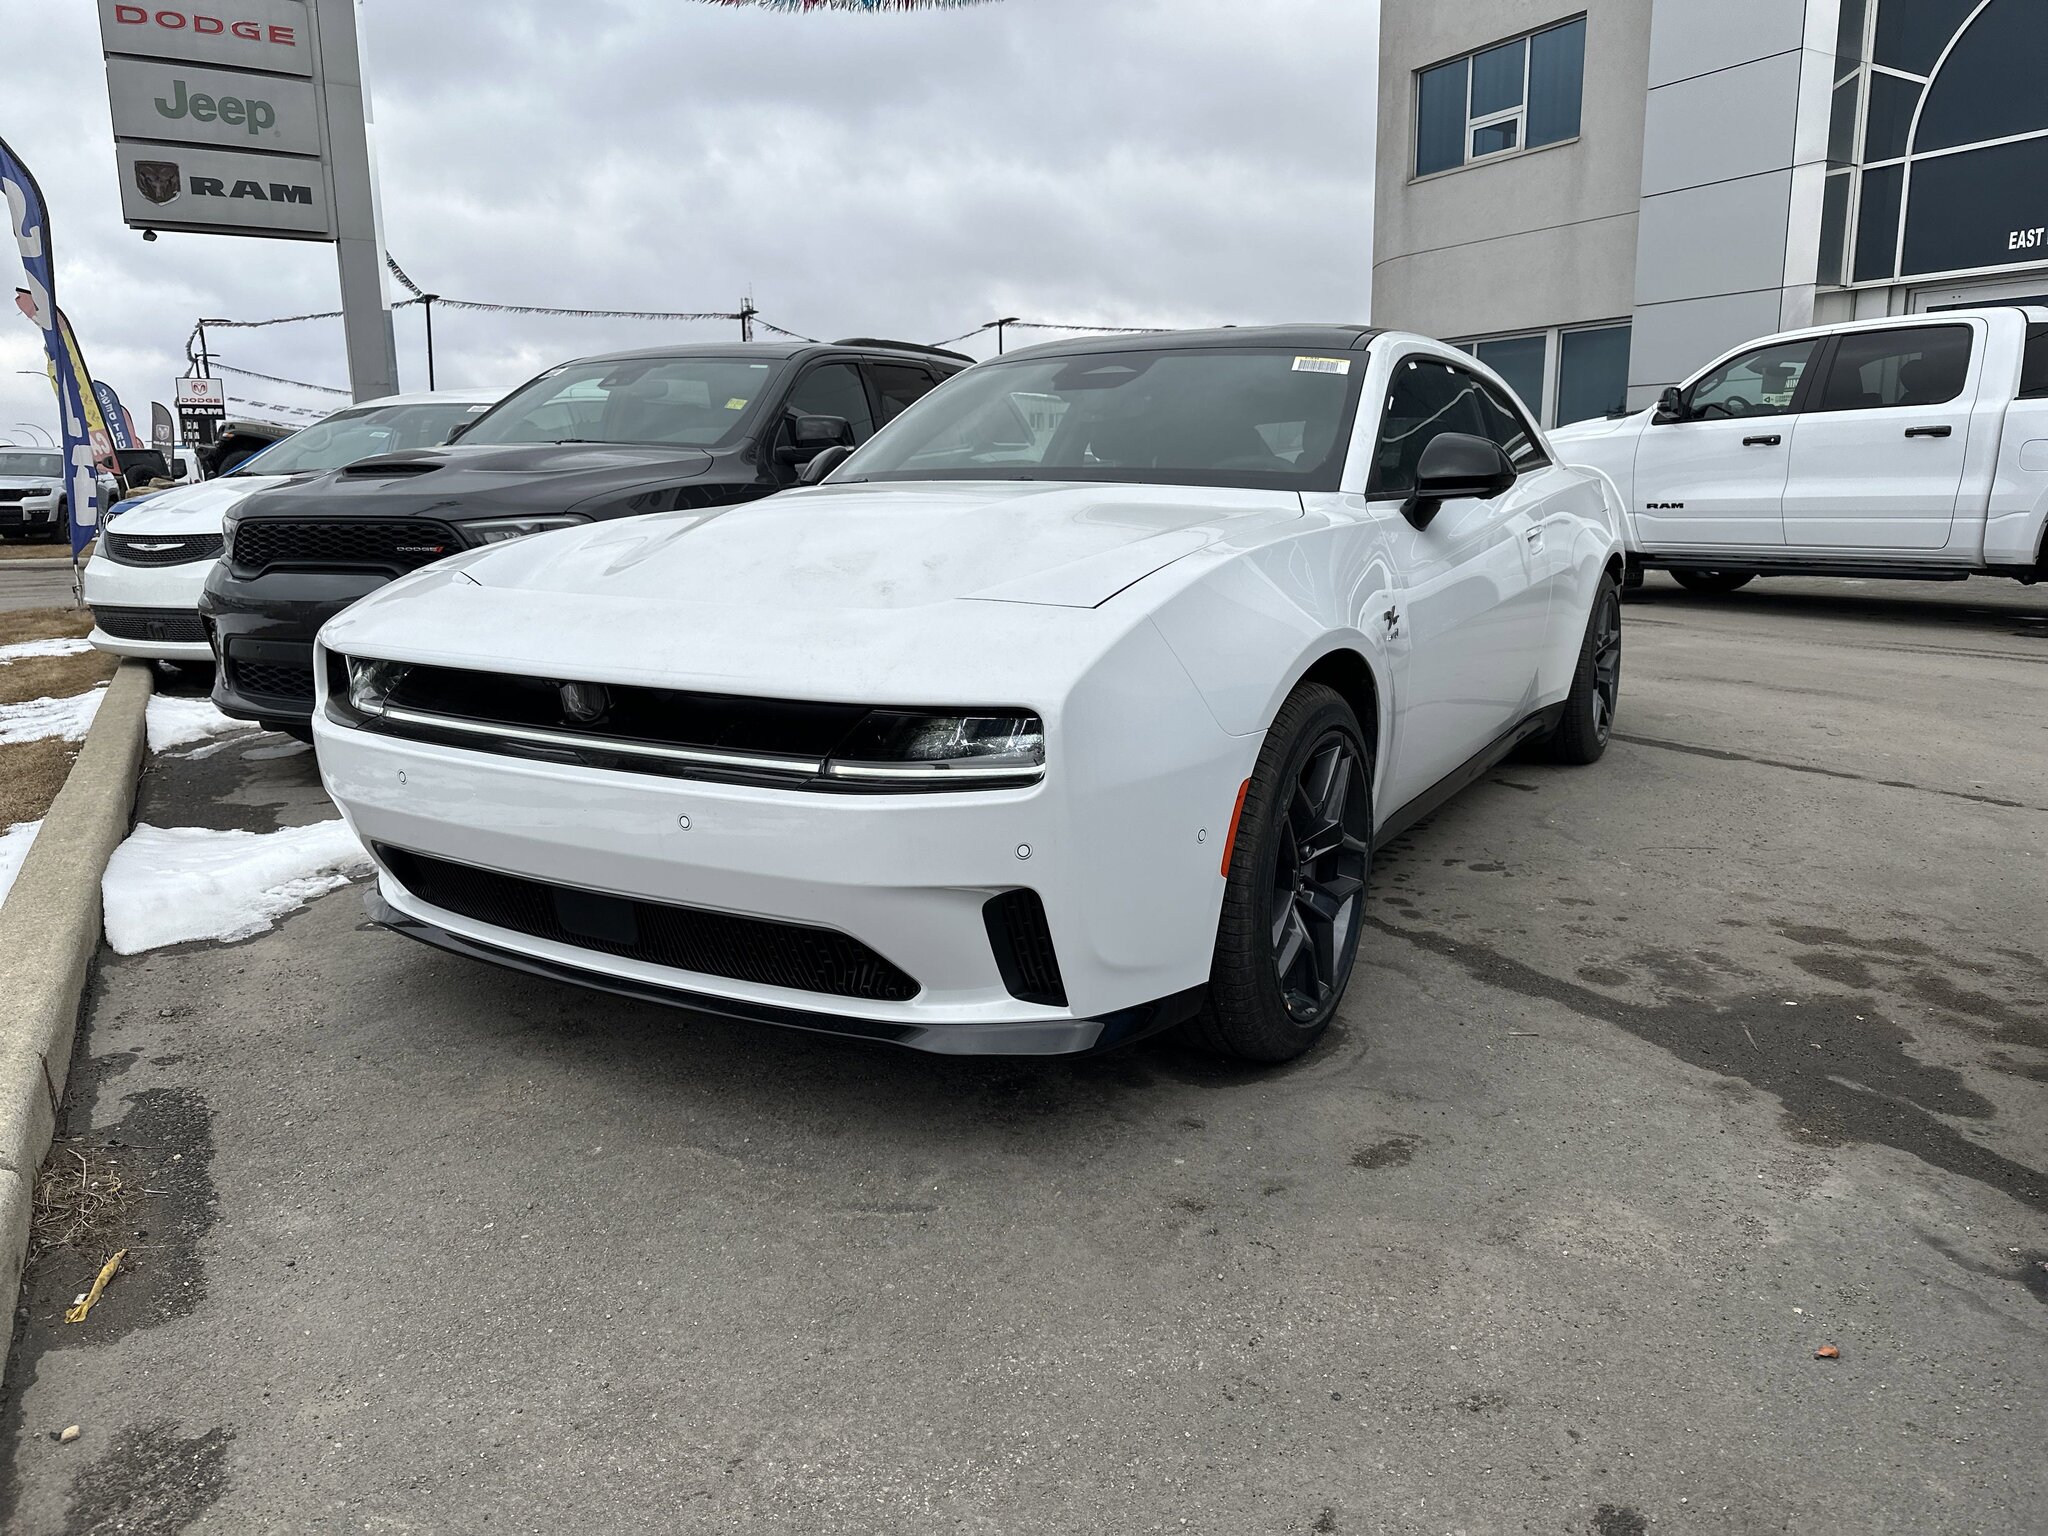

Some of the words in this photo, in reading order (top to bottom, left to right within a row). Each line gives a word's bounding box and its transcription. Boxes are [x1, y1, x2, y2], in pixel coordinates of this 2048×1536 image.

[115, 4, 297, 47] DODGE
[154, 79, 276, 136] Jeep
[189, 176, 313, 205] RAM
[2008, 227, 2045, 250] EAST
[181, 407, 224, 415] RAM
